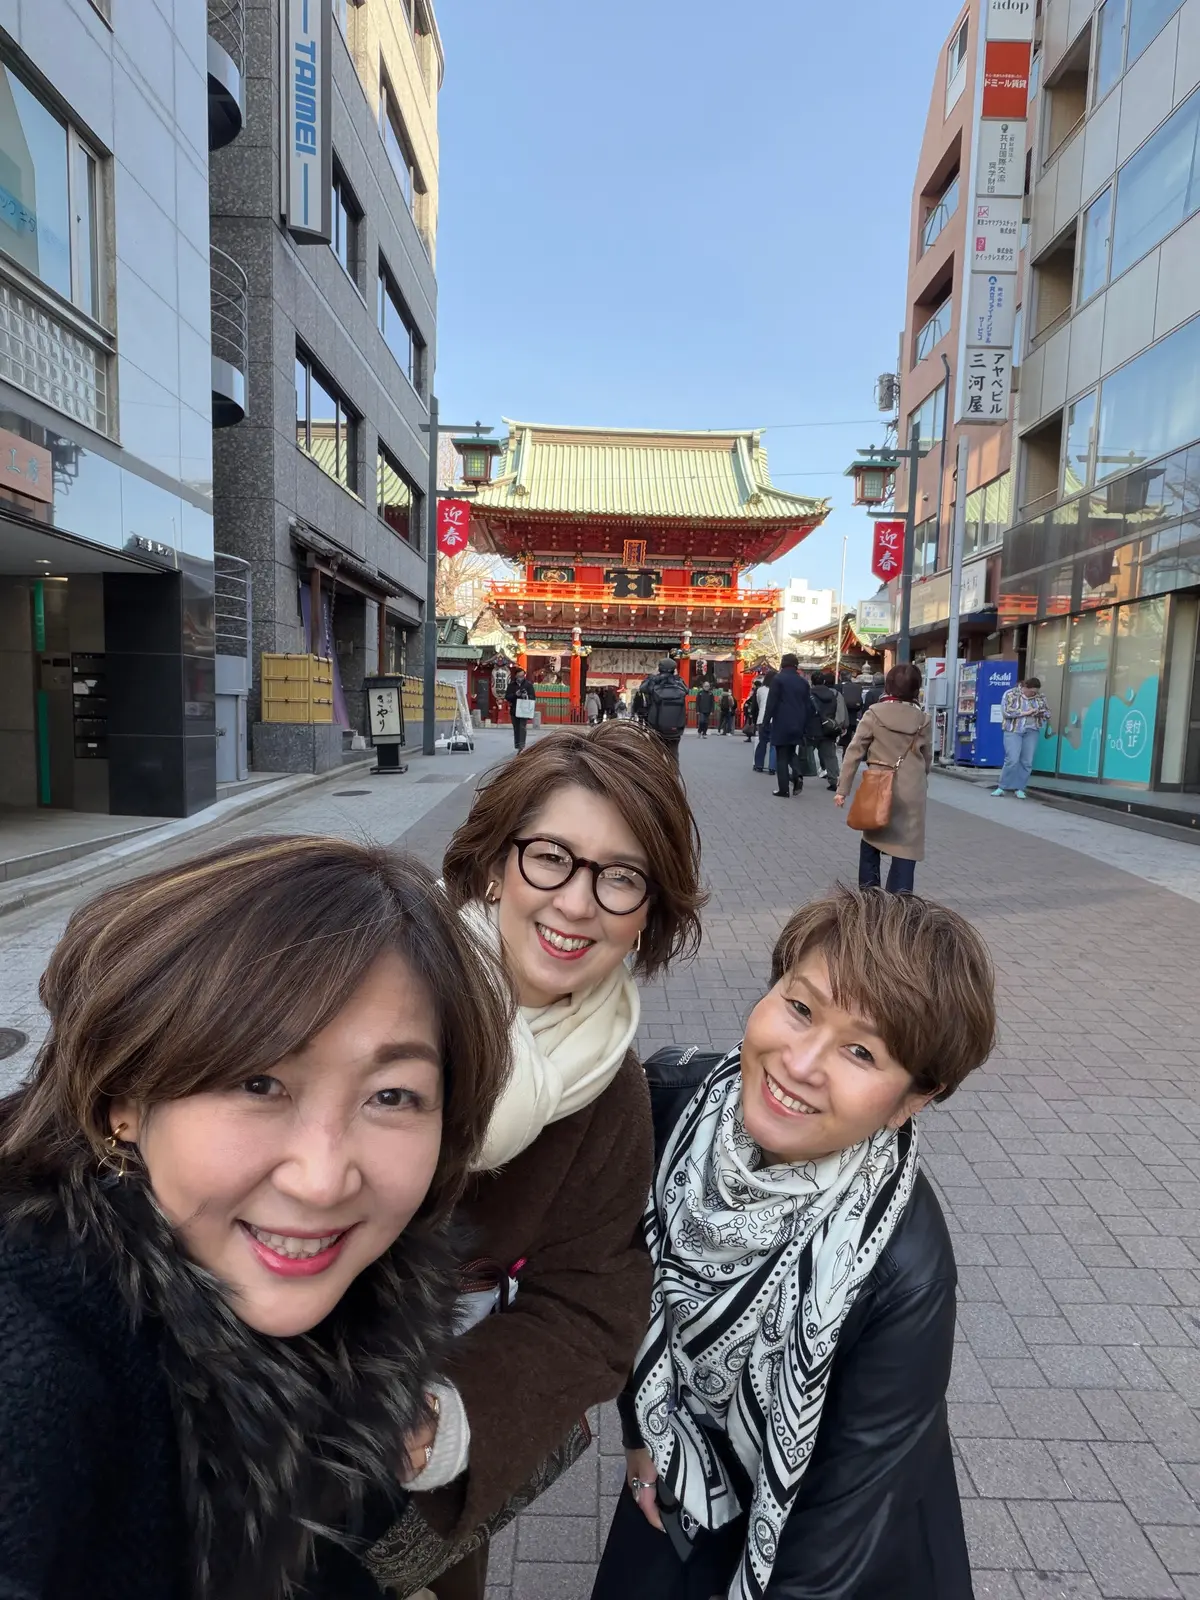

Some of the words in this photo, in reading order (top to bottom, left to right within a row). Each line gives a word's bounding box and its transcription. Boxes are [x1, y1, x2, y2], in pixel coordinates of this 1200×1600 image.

[295, 40, 317, 156] TAIMEI
[967, 353, 987, 414] 三河屋
[989, 353, 1006, 415] アヤベビル
[442, 506, 464, 546] 迎春
[876, 528, 899, 572] 迎春
[989, 672, 1012, 681] Asahi
[1125, 719, 1141, 734] 受付
[1128, 735, 1138, 748] 1F
